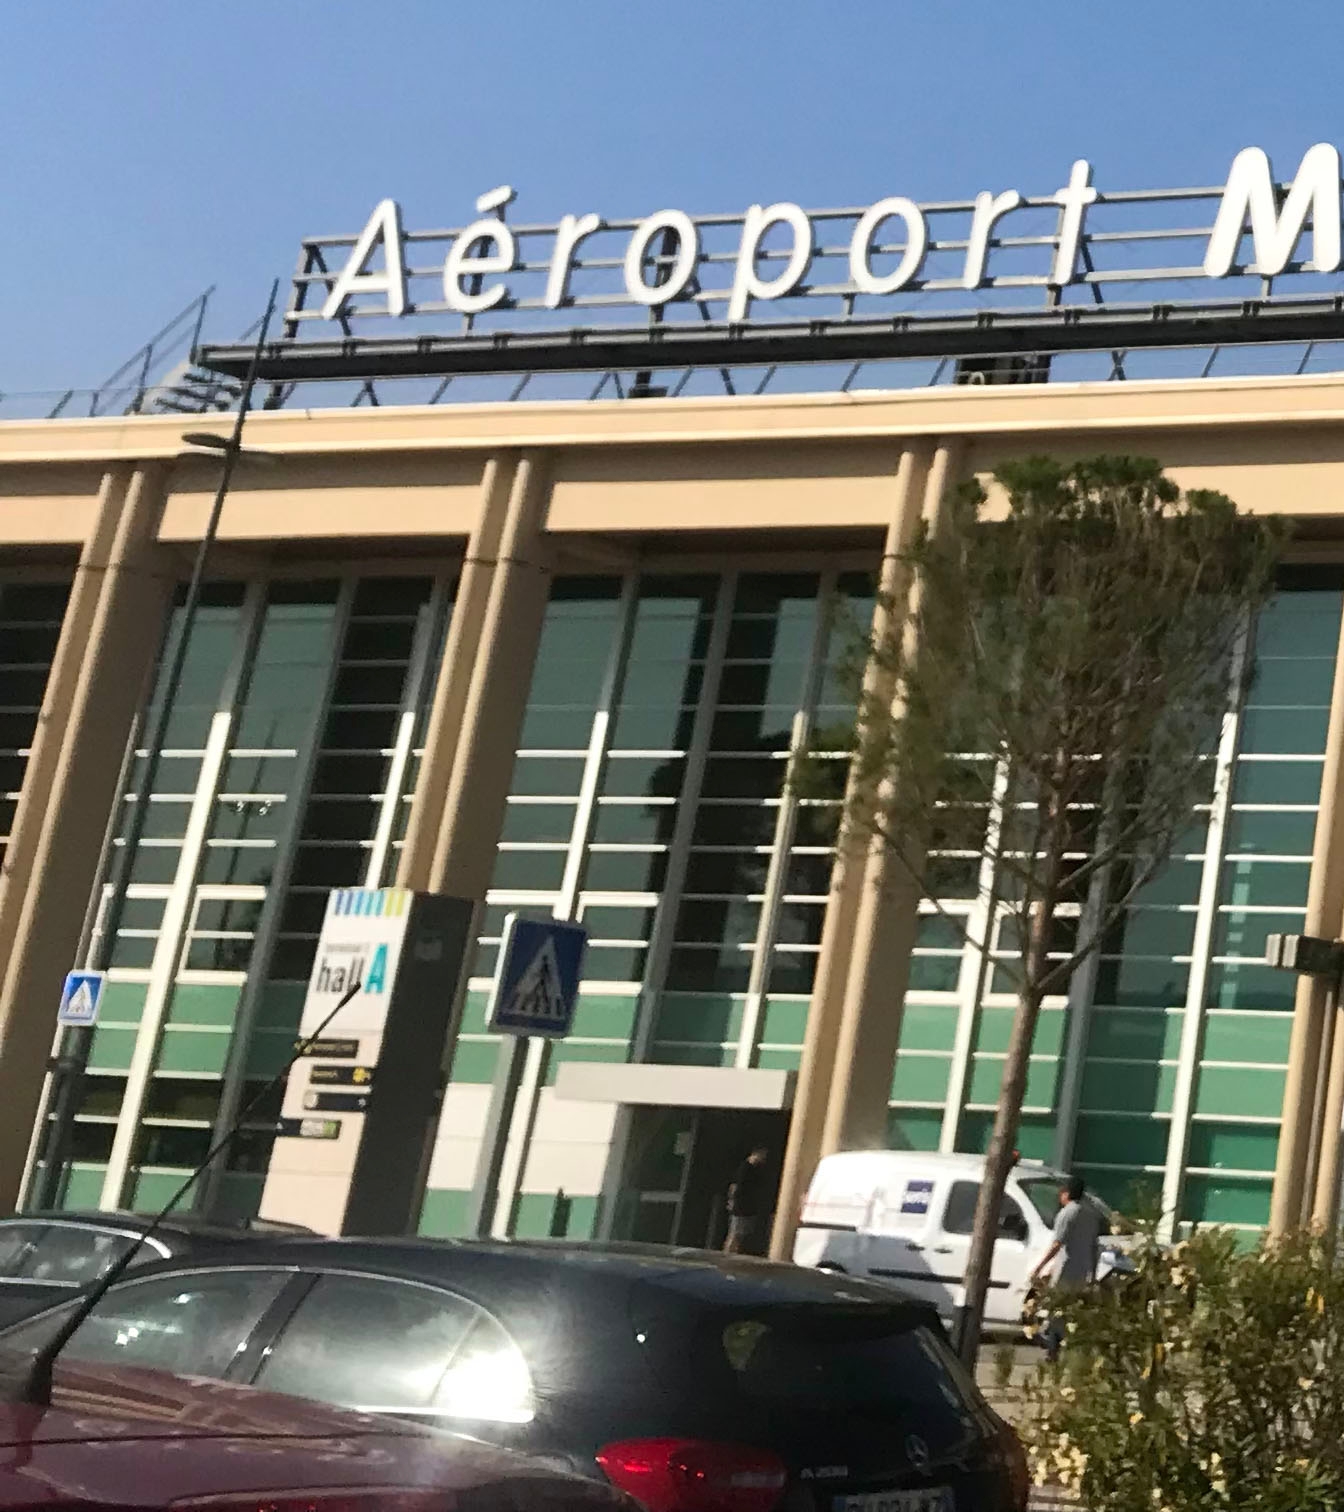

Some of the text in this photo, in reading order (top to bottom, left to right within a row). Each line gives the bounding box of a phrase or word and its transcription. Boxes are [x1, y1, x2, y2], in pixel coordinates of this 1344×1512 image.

[323, 159, 1098, 322] Aéroport
[316, 943, 388, 994] hall A
